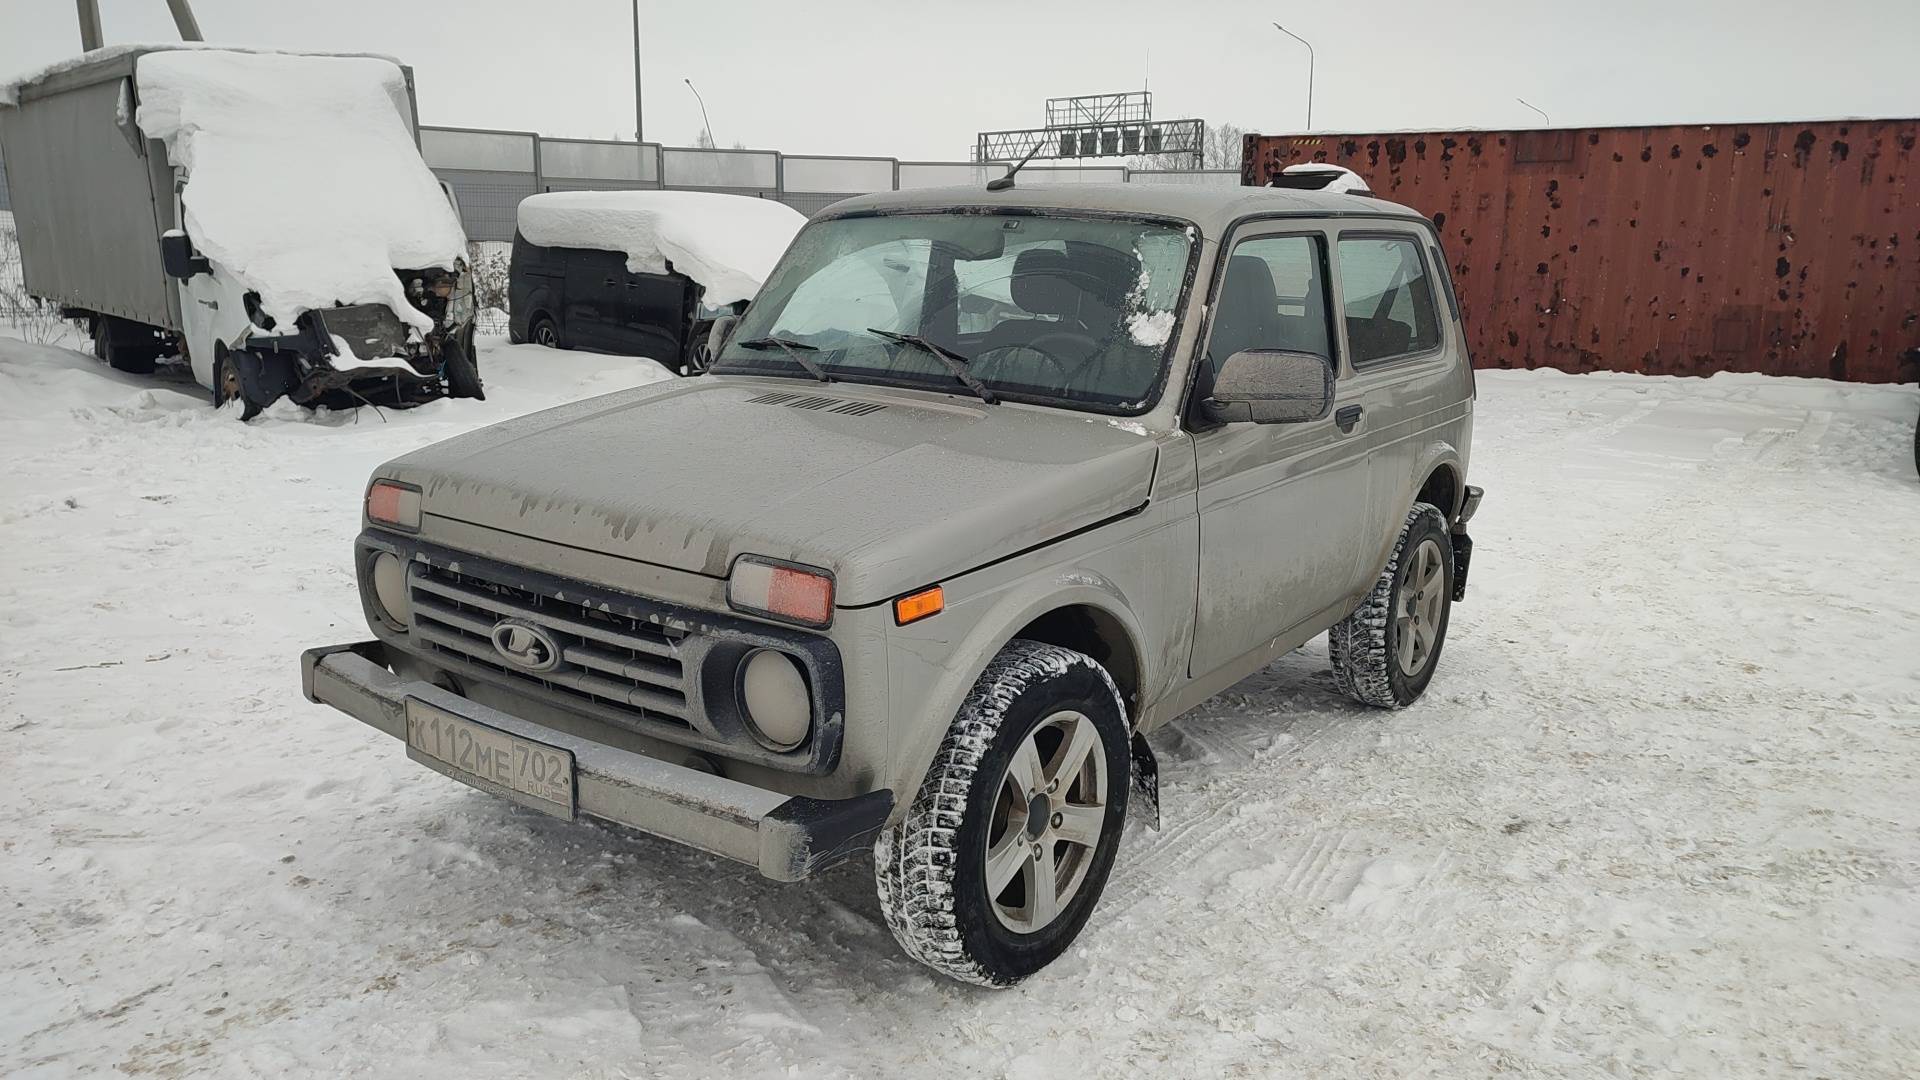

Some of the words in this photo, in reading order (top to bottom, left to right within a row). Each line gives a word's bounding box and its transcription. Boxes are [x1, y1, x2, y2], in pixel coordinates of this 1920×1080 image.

[415, 717, 511, 783] К112МЕ
[515, 745, 563, 788] 702
[527, 780, 553, 797] RUS
